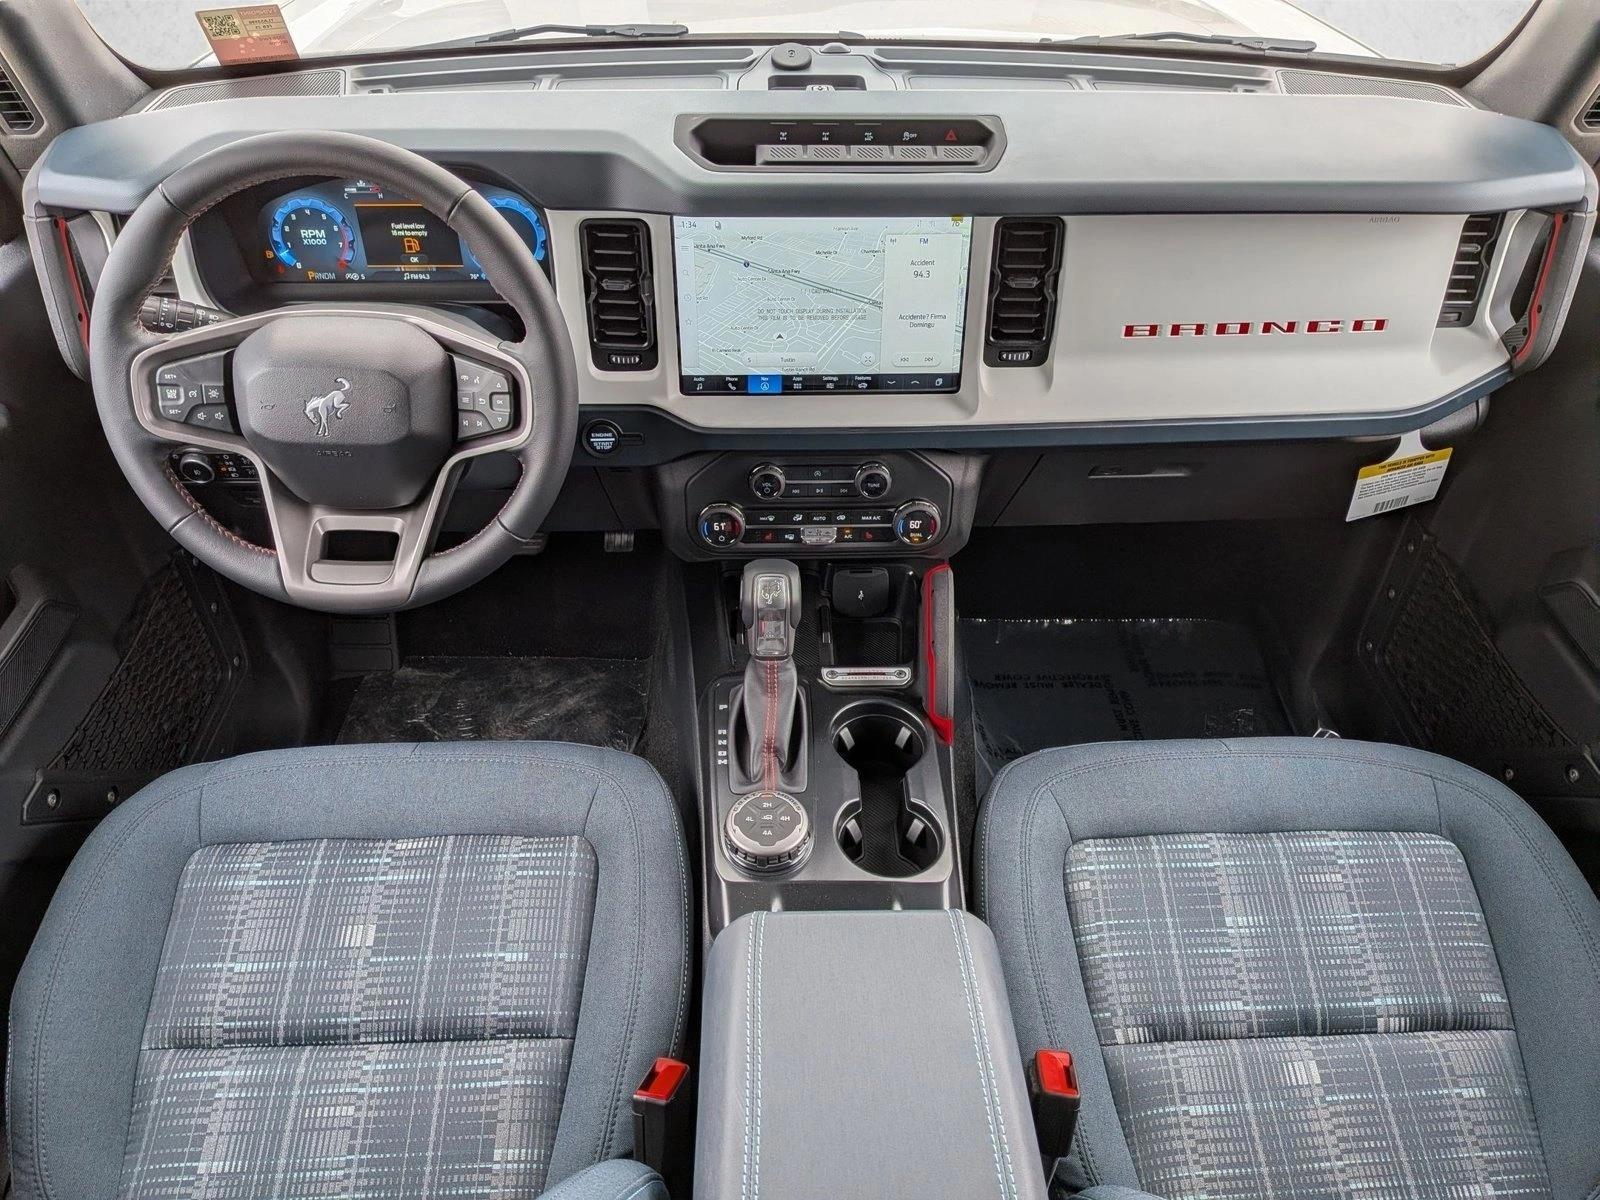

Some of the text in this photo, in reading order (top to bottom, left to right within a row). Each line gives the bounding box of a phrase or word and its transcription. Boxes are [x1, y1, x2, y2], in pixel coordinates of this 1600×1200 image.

[301, 230, 326, 238] RPM
[914, 270, 930, 278] 94.3
[1121, 318, 1388, 338] BRONCO
